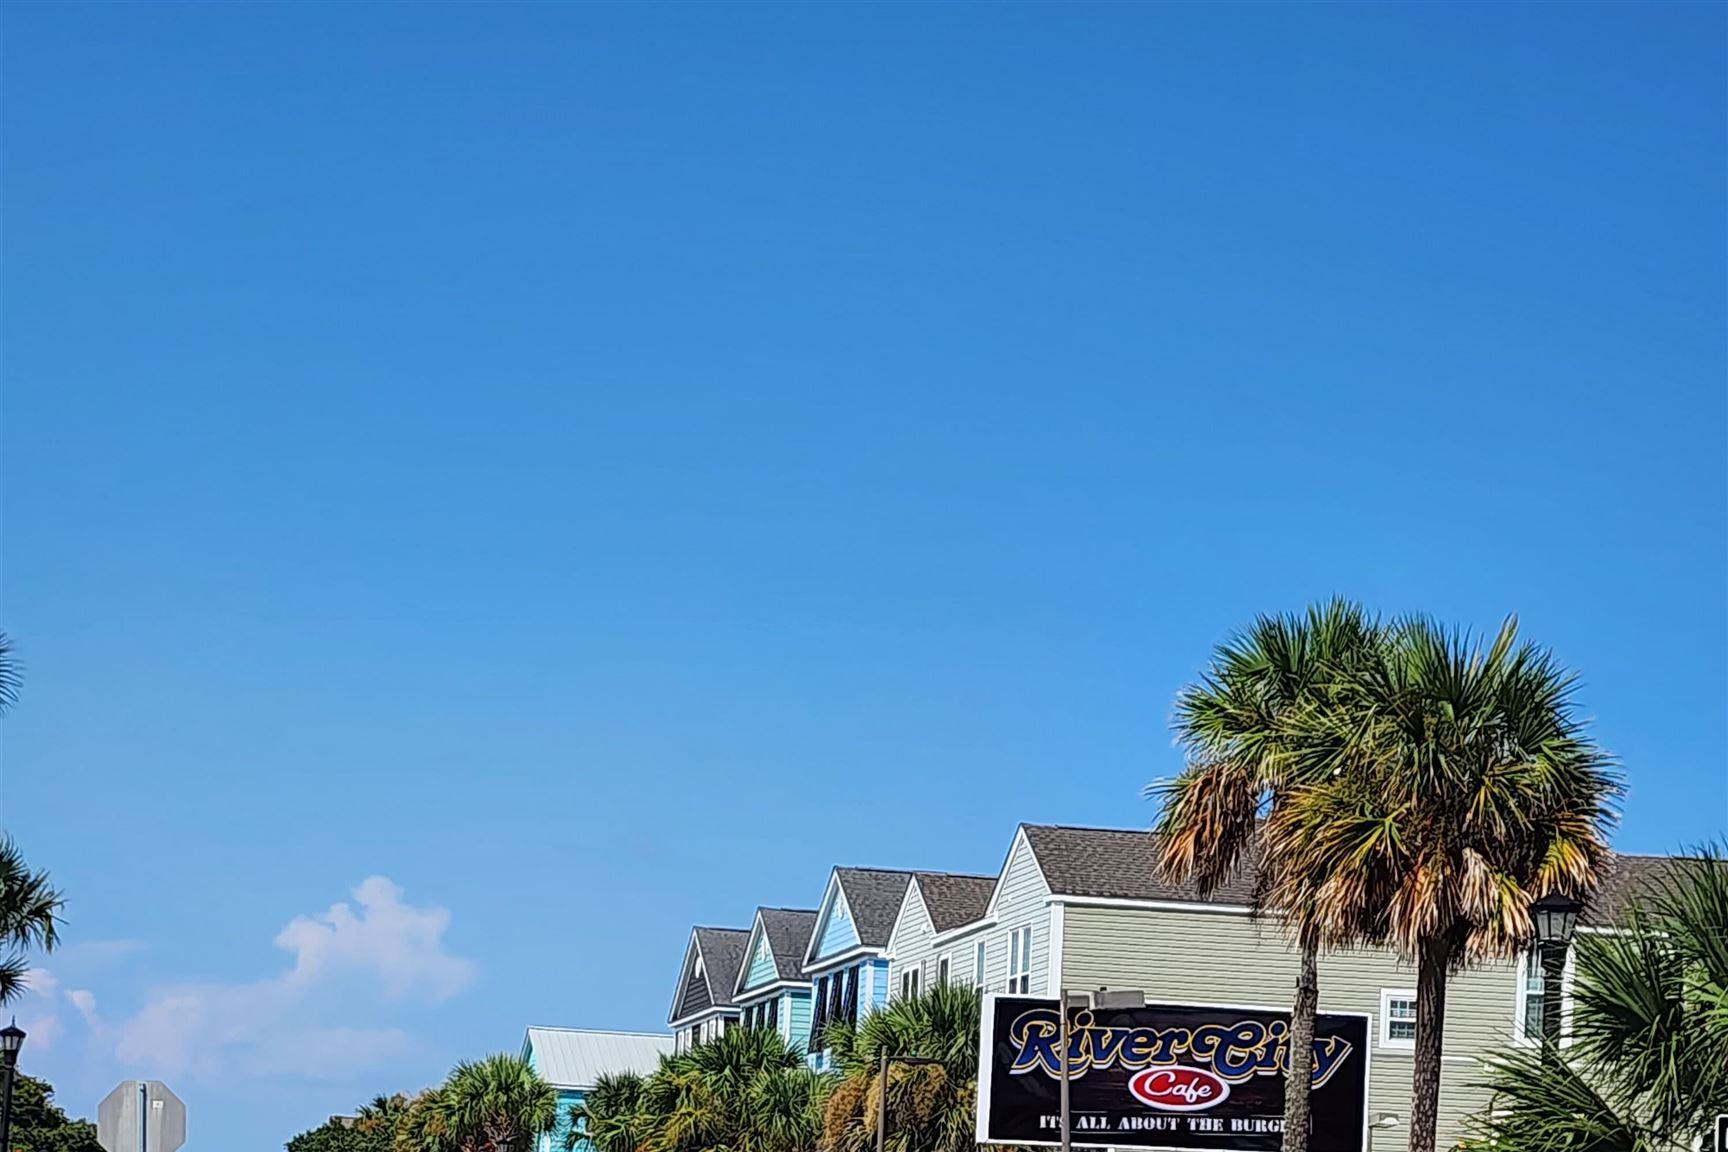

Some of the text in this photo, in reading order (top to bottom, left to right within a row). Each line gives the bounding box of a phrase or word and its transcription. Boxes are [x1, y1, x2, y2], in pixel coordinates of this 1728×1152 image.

[1009, 1008, 1353, 1090] River Ciy
[1143, 1071, 1213, 1104] Cafe
[1076, 1116, 1111, 1130] ALL
[1118, 1117, 1180, 1131] ABOUT
[1187, 1118, 1223, 1132] THE
